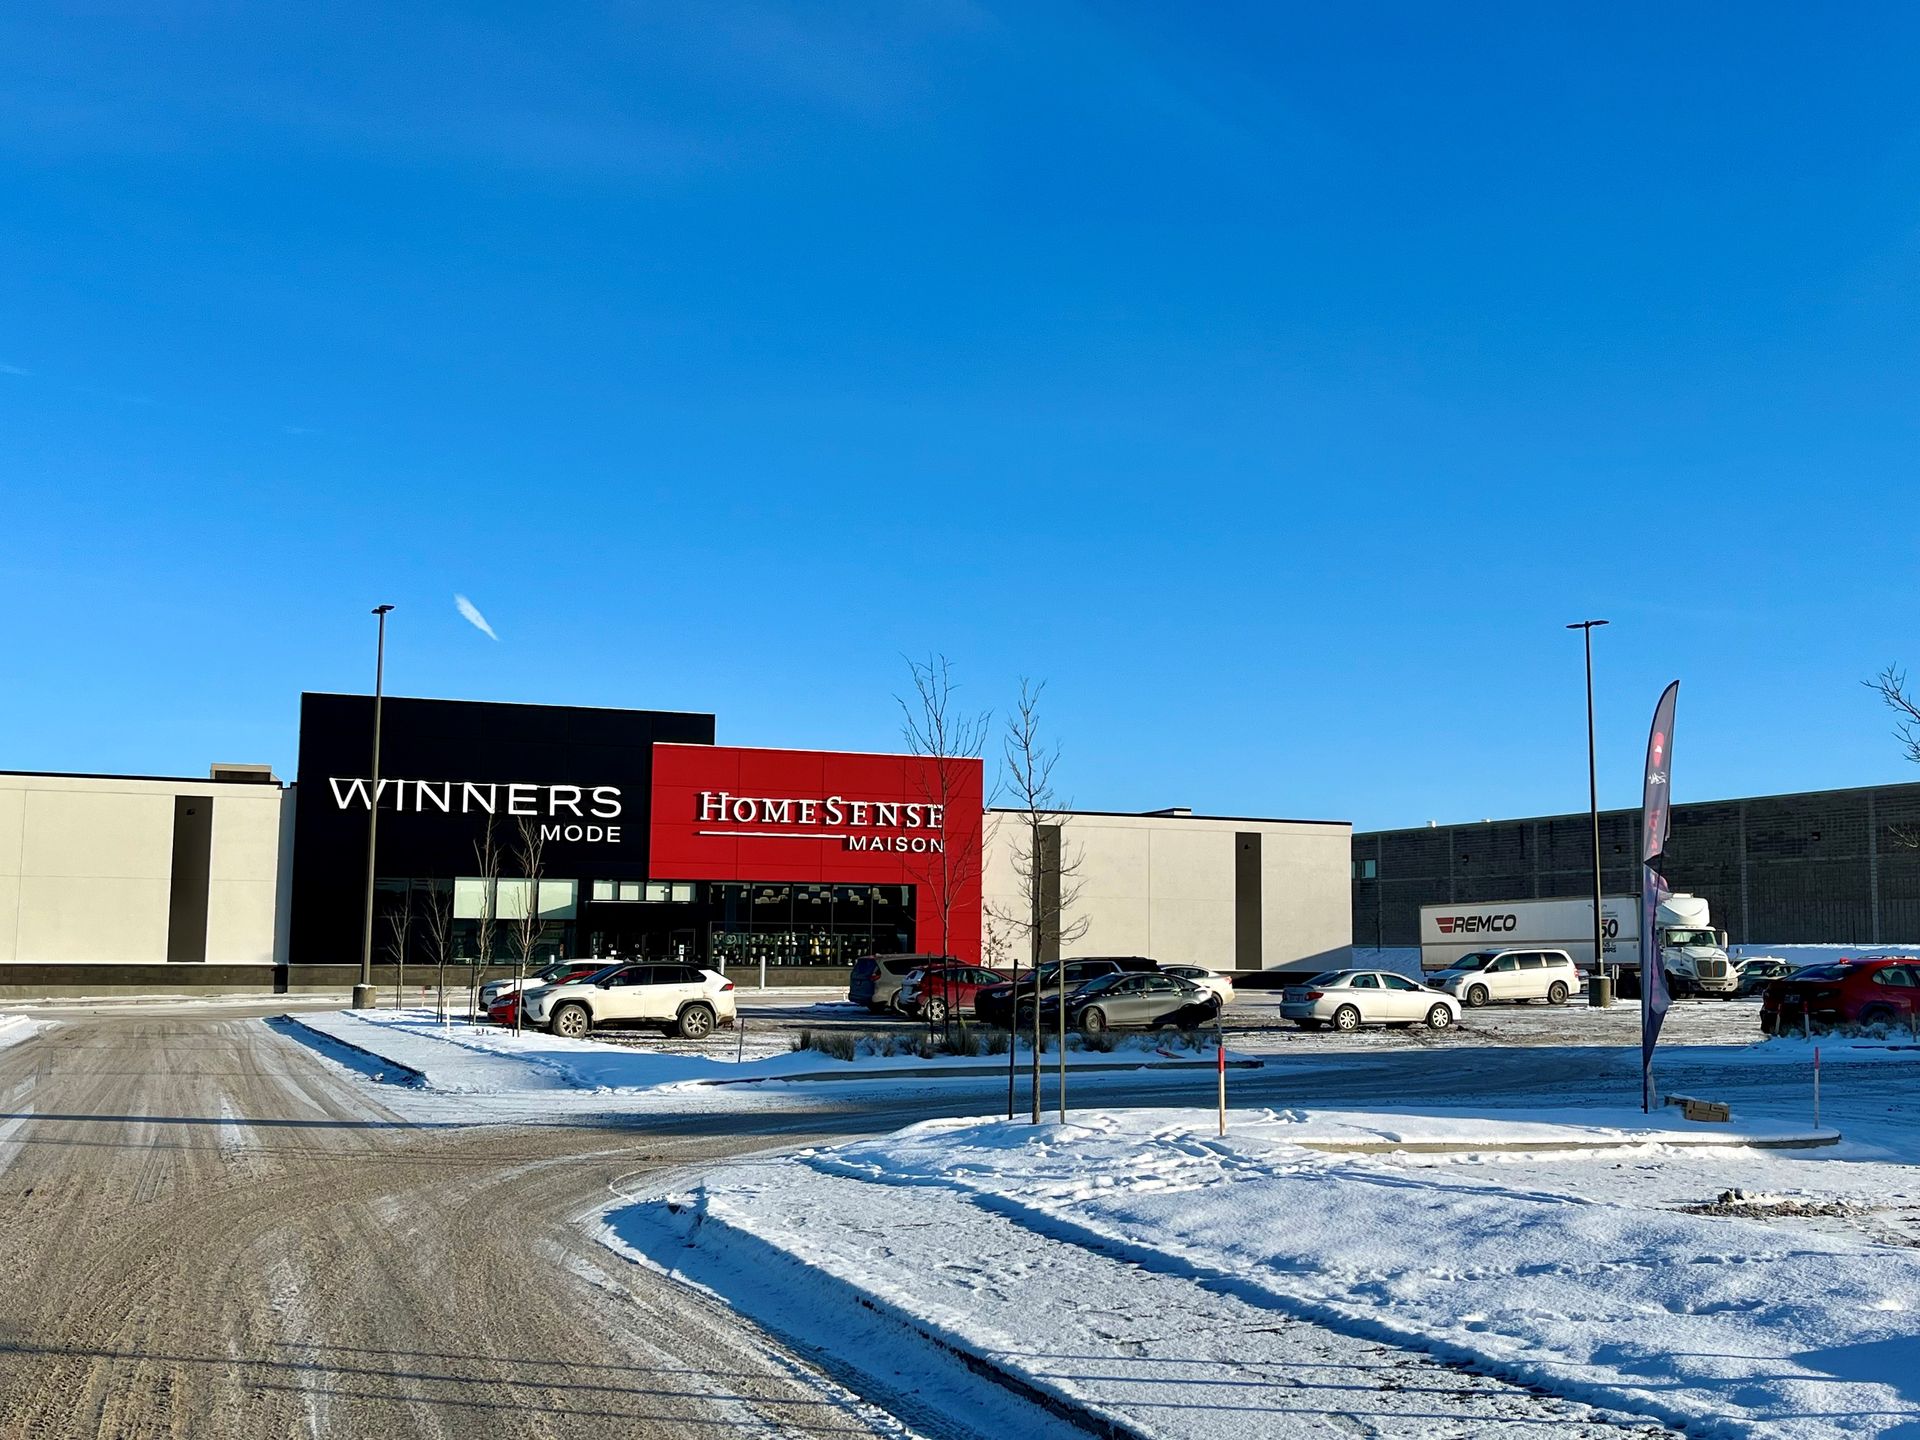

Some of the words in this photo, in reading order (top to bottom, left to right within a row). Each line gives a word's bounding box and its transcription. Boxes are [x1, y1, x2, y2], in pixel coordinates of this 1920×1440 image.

[329, 777, 622, 818] WINNERS
[540, 824, 621, 843] MODE
[849, 836, 943, 853] MAISON
[1453, 914, 1517, 933] REMCO
